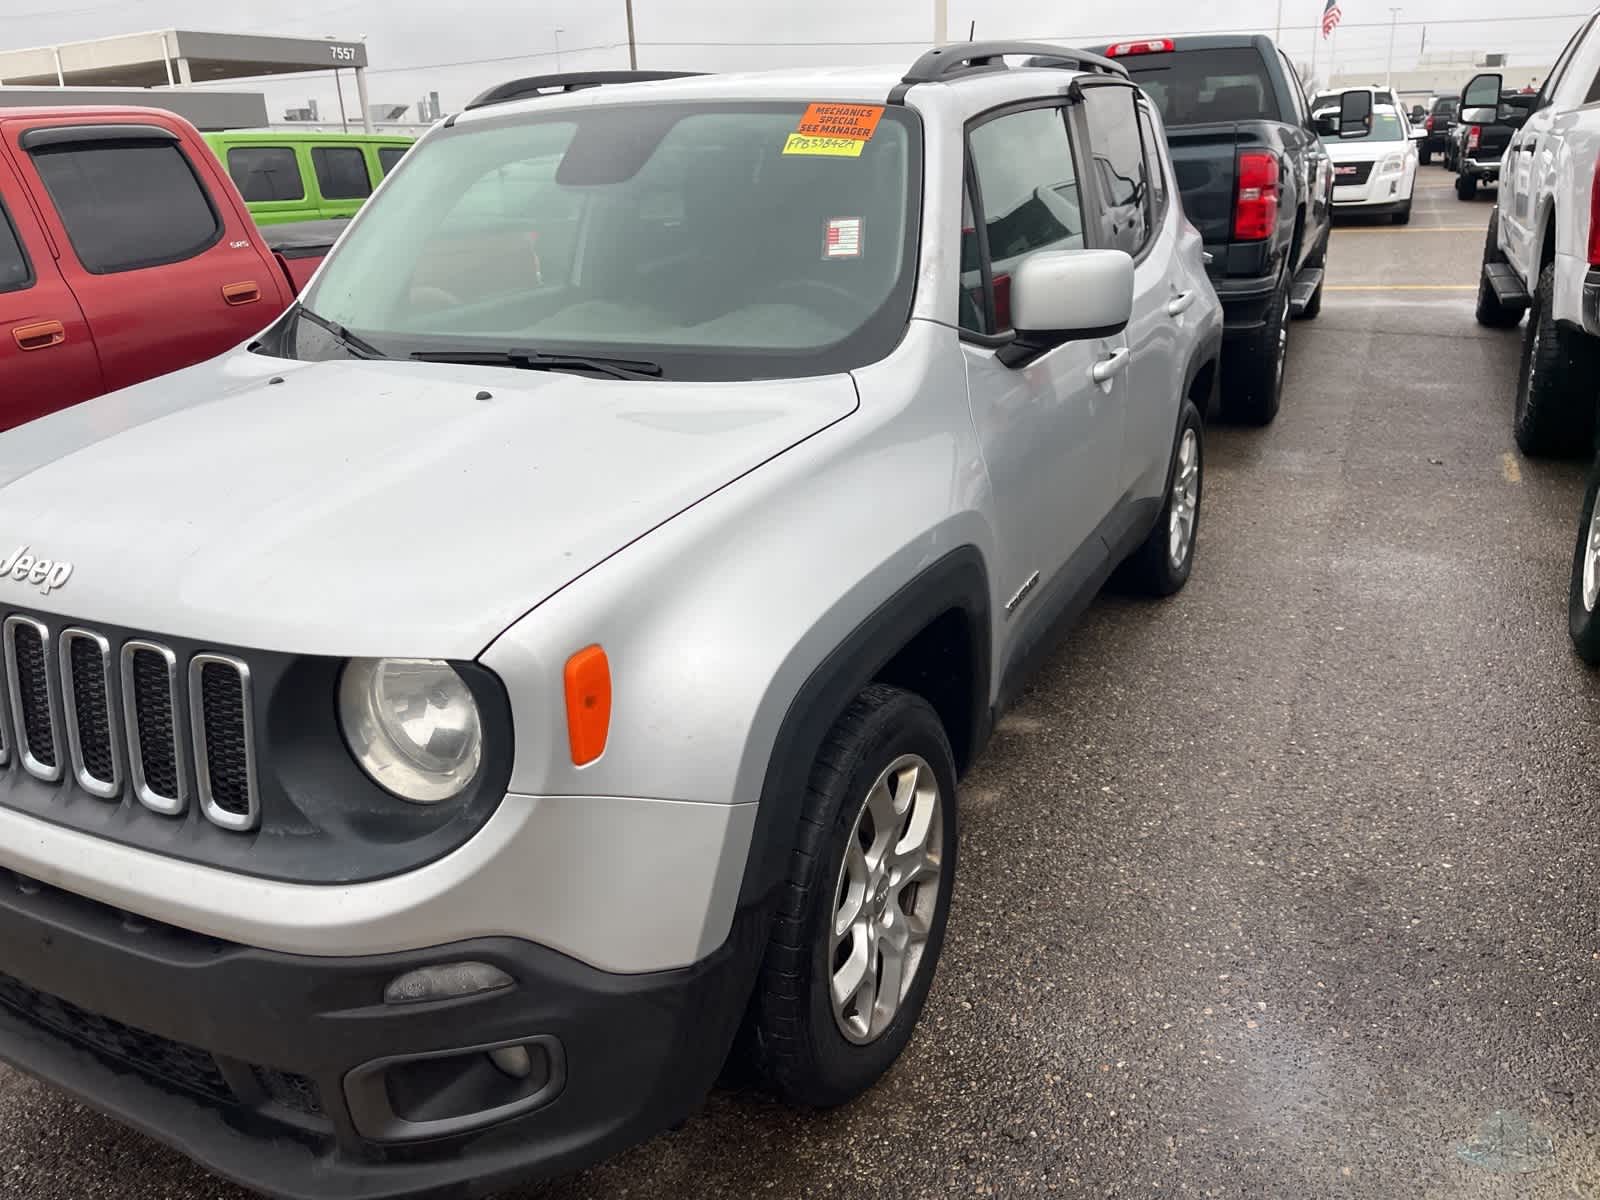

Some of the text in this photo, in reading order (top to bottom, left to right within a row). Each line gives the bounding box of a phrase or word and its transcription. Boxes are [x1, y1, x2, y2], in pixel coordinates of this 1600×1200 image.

[329, 46, 355, 60] 7557
[815, 107, 873, 118] MECHANICS
[818, 116, 858, 126] SPECIAL
[800, 124, 870, 137] SEE MANAGER
[1334, 166, 1357, 175] MC
[0, 544, 74, 596] Jeep
